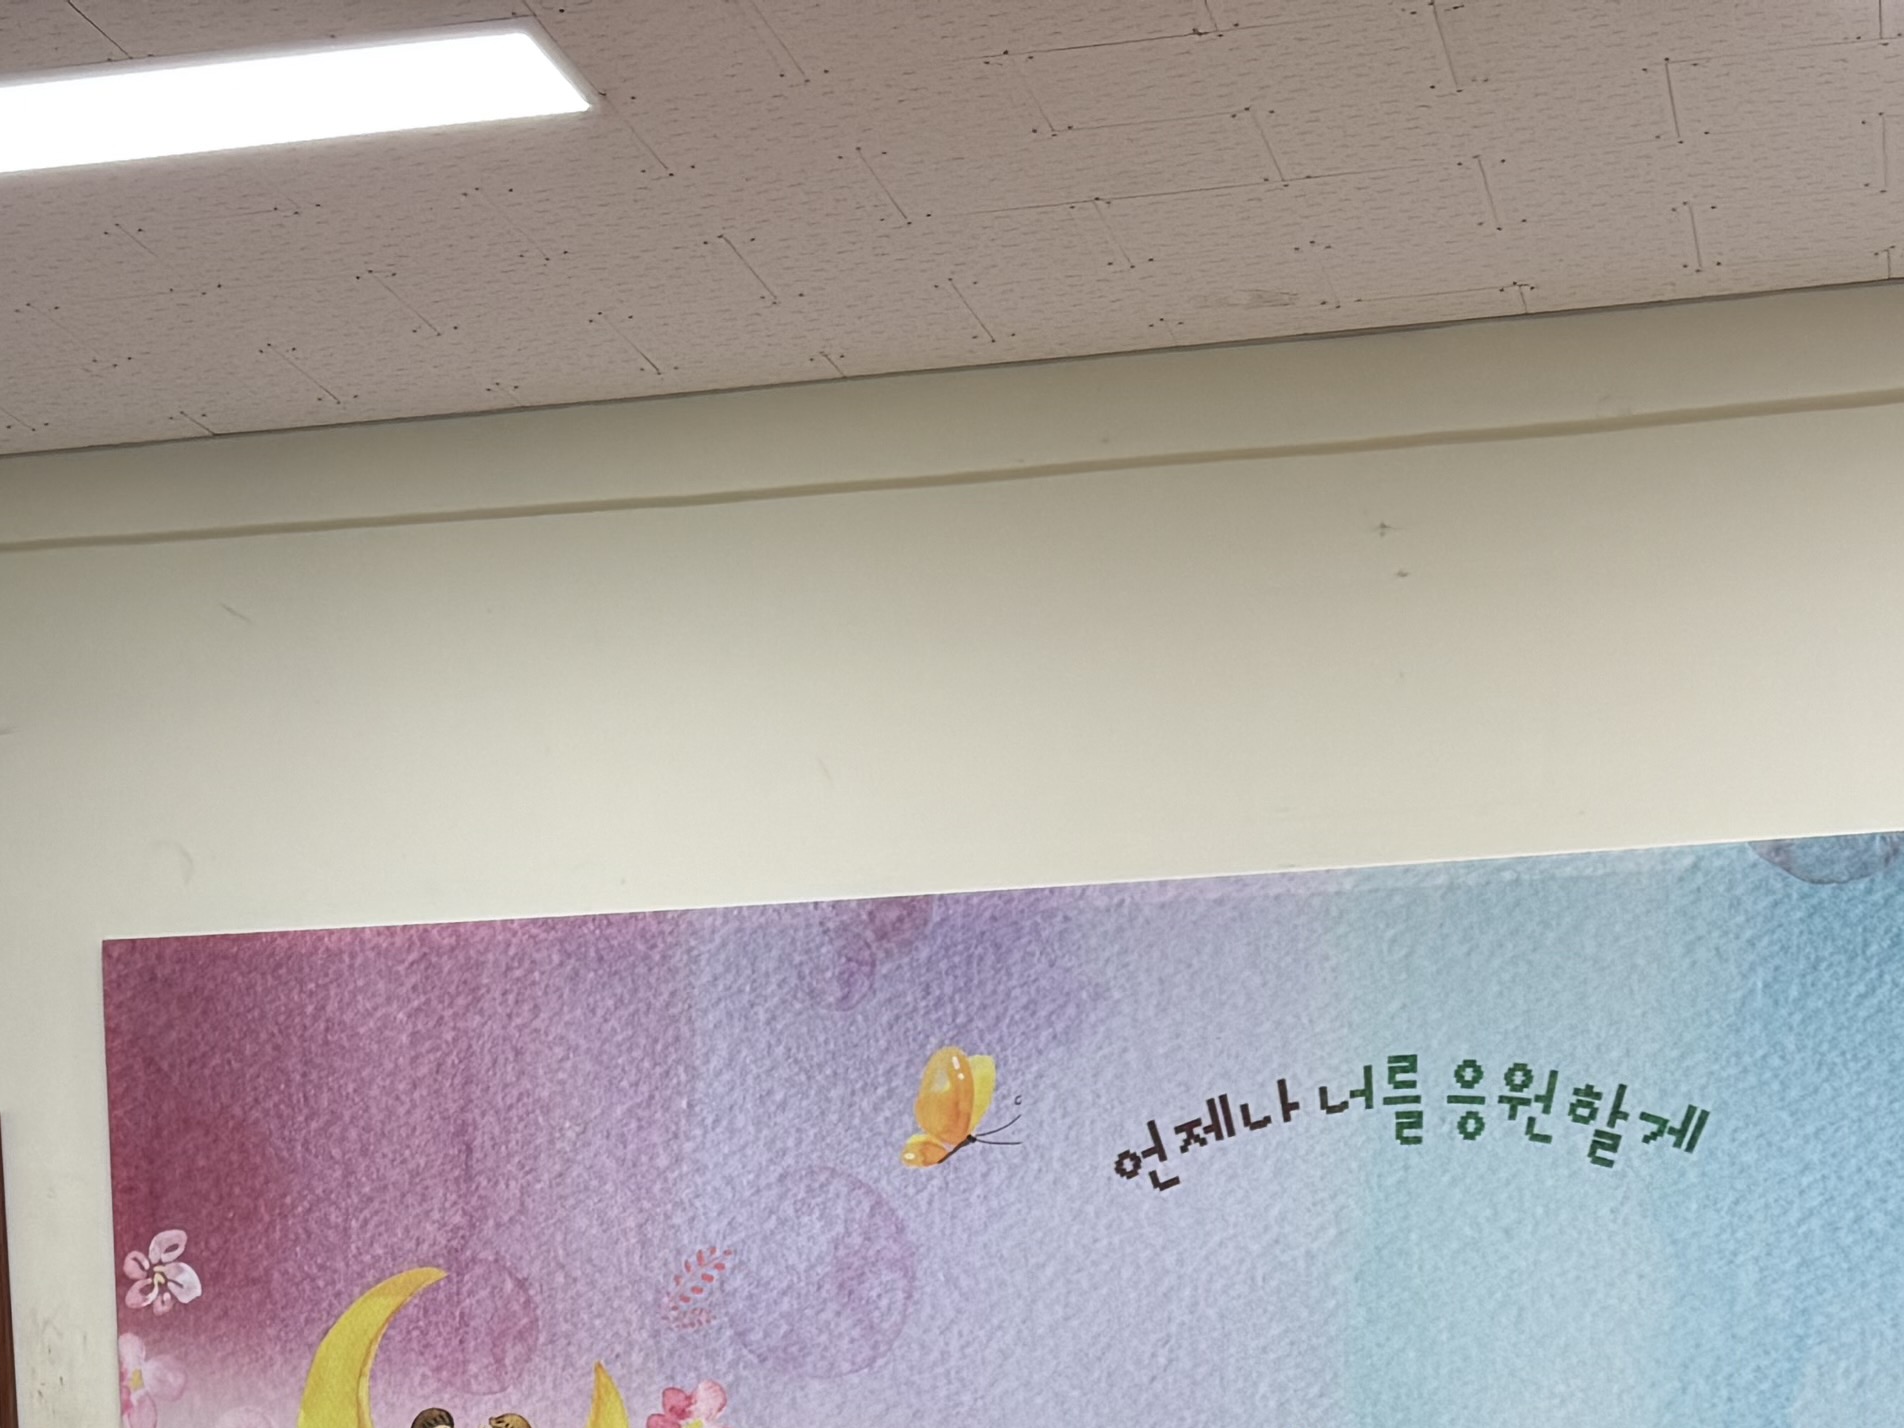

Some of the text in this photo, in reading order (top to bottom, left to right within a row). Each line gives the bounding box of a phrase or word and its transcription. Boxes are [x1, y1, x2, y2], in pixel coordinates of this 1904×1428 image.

[1114, 1054, 1711, 1191] 언제나 너를 응원할게
